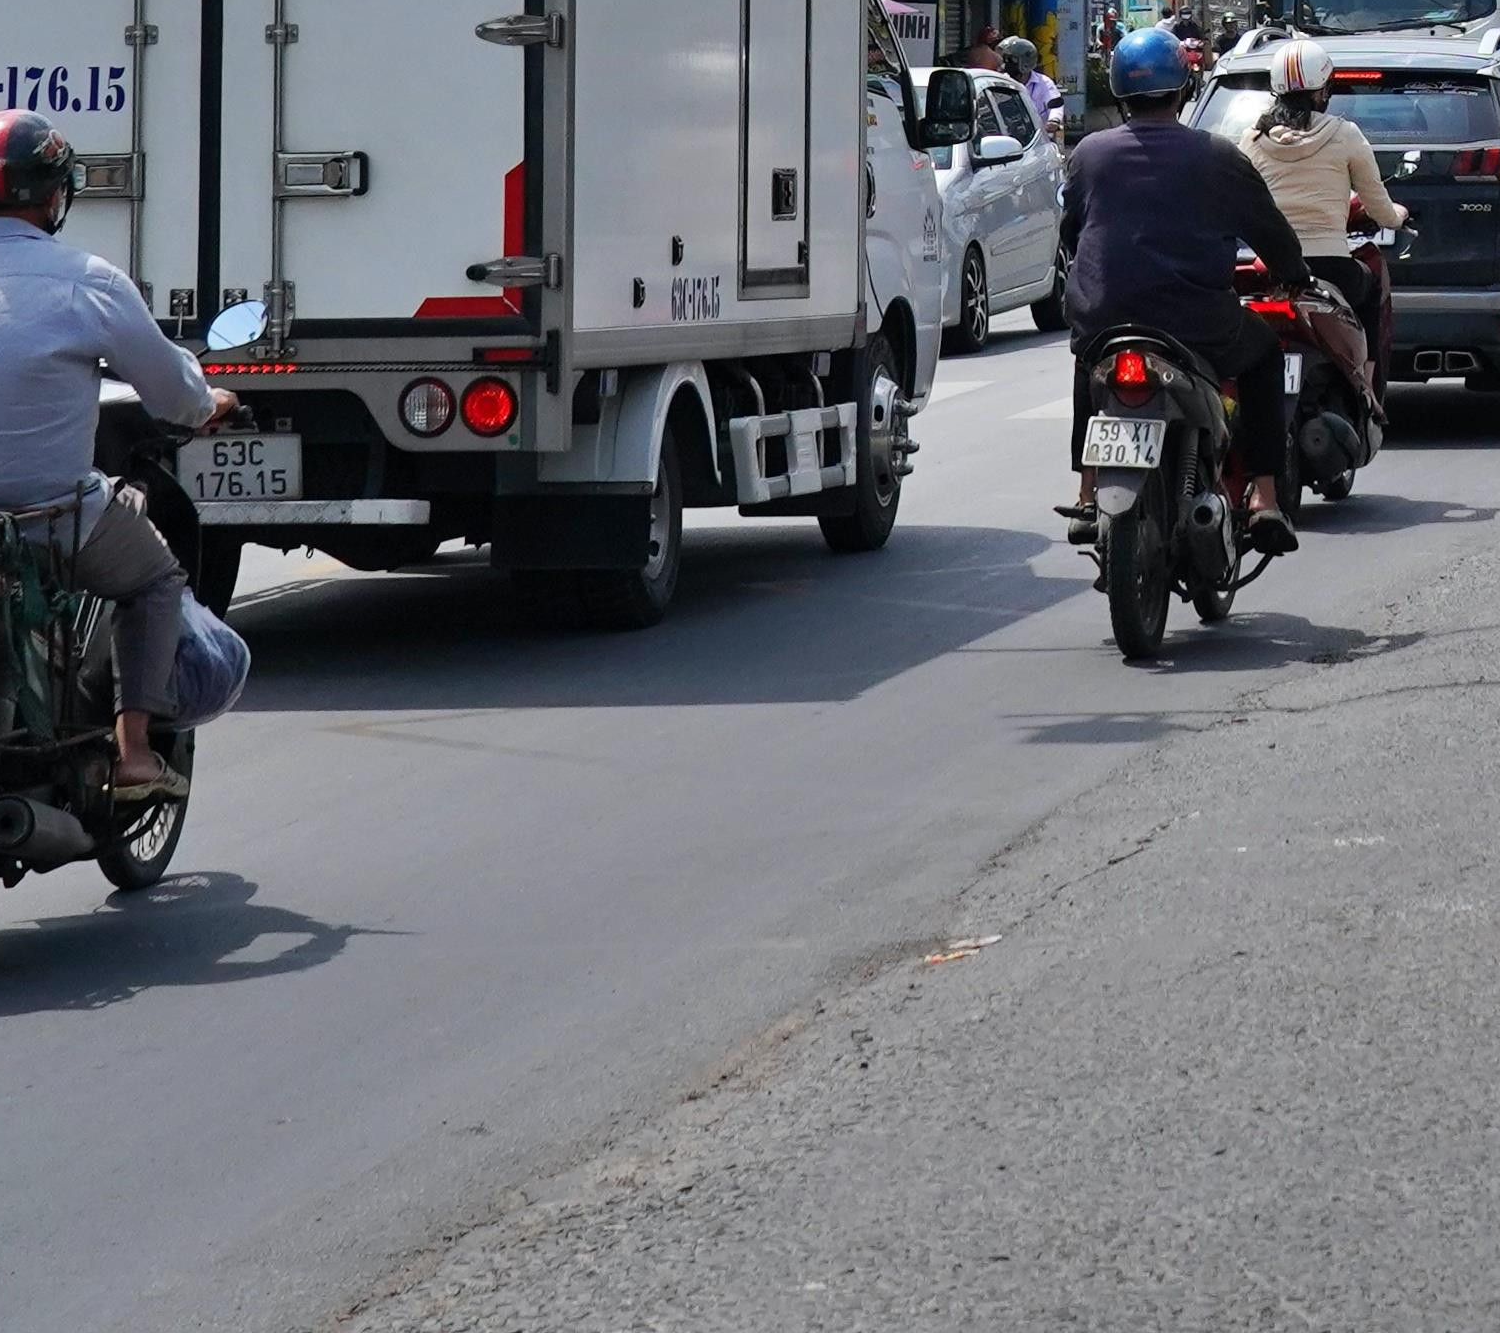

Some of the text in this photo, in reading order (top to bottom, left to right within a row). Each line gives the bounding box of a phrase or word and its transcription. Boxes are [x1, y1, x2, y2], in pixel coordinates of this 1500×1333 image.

[671, 274, 721, 322] 63C-176.15
[1099, 422, 1151, 442] 59 X1
[212, 439, 265, 467] 63C
[194, 470, 288, 499] 176.15
